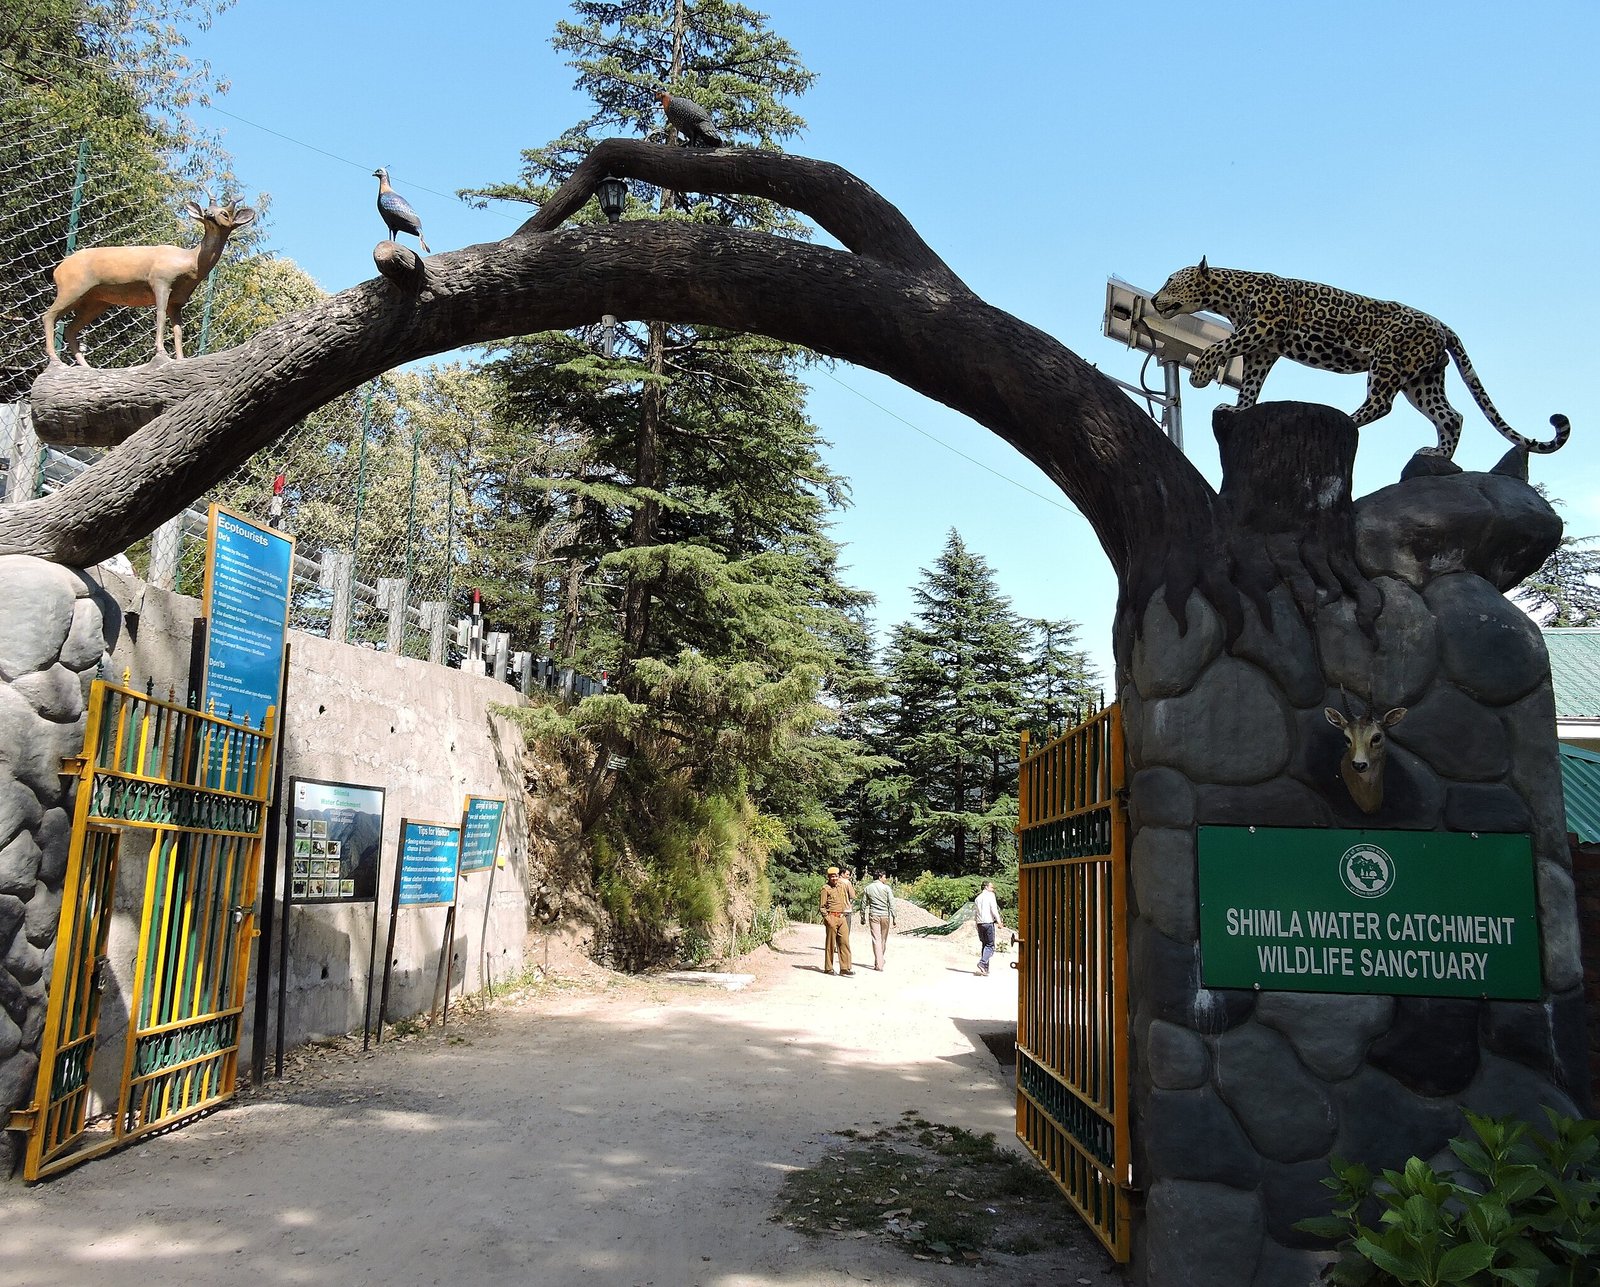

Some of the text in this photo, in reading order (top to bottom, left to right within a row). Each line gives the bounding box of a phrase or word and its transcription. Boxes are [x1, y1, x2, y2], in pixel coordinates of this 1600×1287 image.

[217, 516, 269, 547] Ecotourists
[217, 531, 231, 542] Do's
[336, 799, 361, 808] Catchment
[418, 825, 428, 836] Tips
[1226, 907, 1515, 945] SHIMLA WATER CATCHMENT
[1257, 945, 1488, 980] WILDLIFE SANCTUARY
